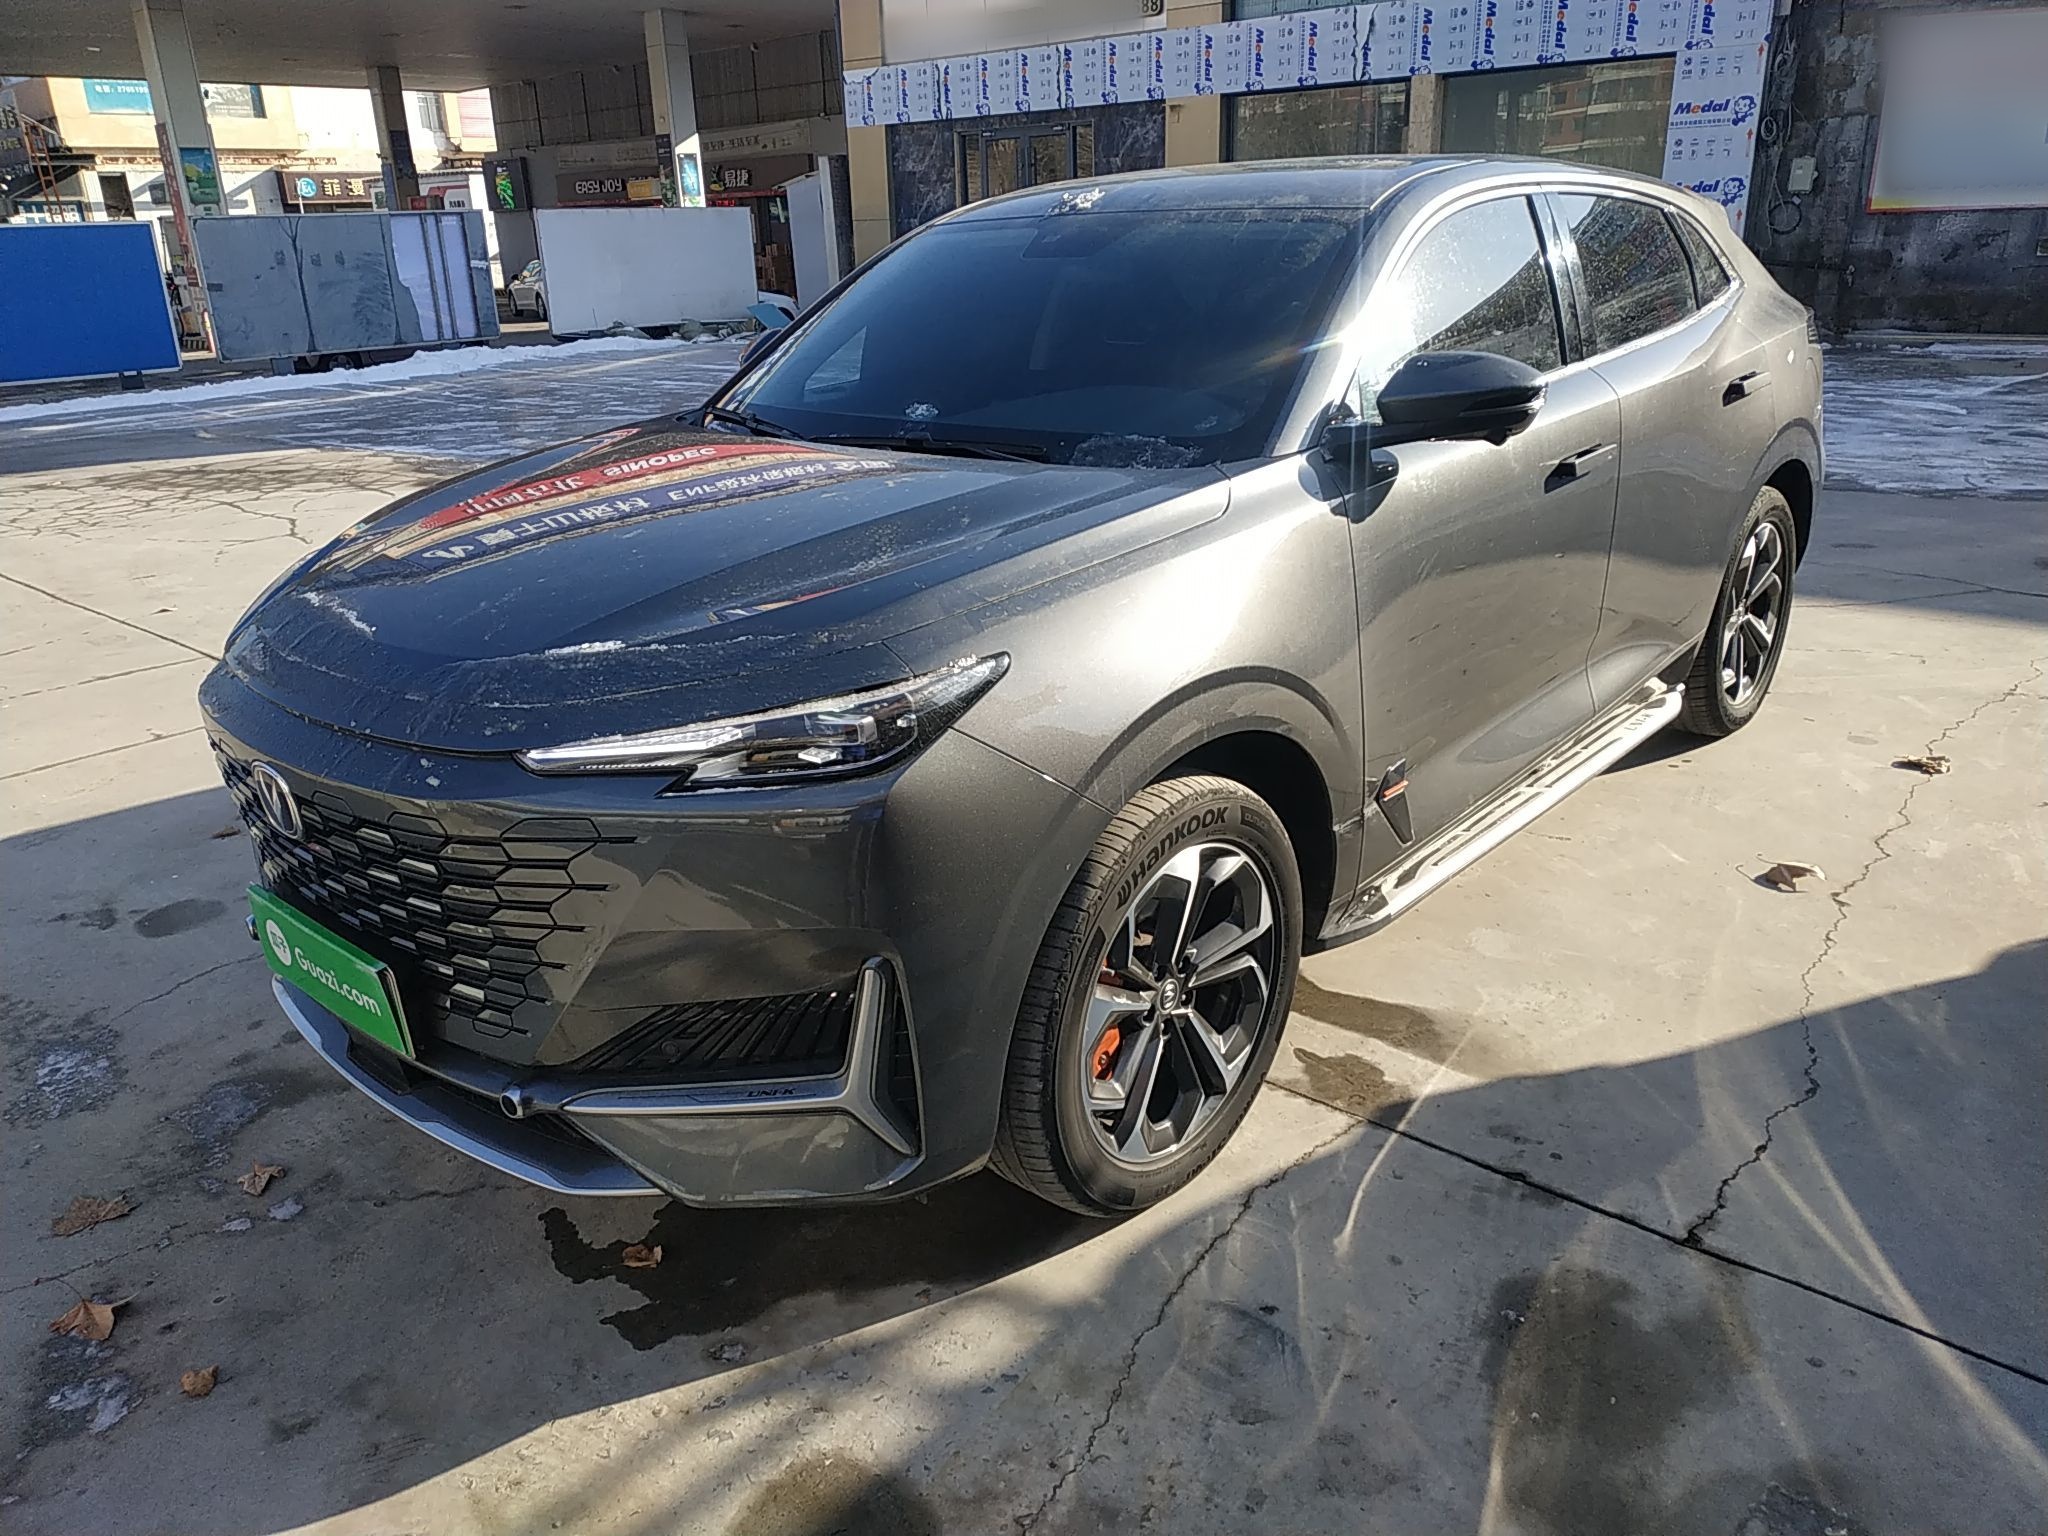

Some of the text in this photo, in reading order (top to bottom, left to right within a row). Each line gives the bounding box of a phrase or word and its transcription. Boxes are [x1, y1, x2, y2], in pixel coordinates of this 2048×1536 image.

[1420, 7, 1434, 62] Medal
[1483, 0, 1498, 56] Medal
[1625, 0, 1641, 43] edal
[1108, 42, 1118, 88] Medal
[1155, 36, 1164, 84] Medal
[1204, 34, 1213, 83] Medal
[1254, 28, 1265, 78] Medal
[1308, 21, 1318, 73] Medal
[981, 58, 990, 101] Medal
[1020, 53, 1030, 97] Medal
[1673, 98, 1732, 116] Medal
[575, 178, 623, 194] EASY JOY
[724, 168, 749, 188] 易捷
[294, 946, 383, 1018] Guazi.com
